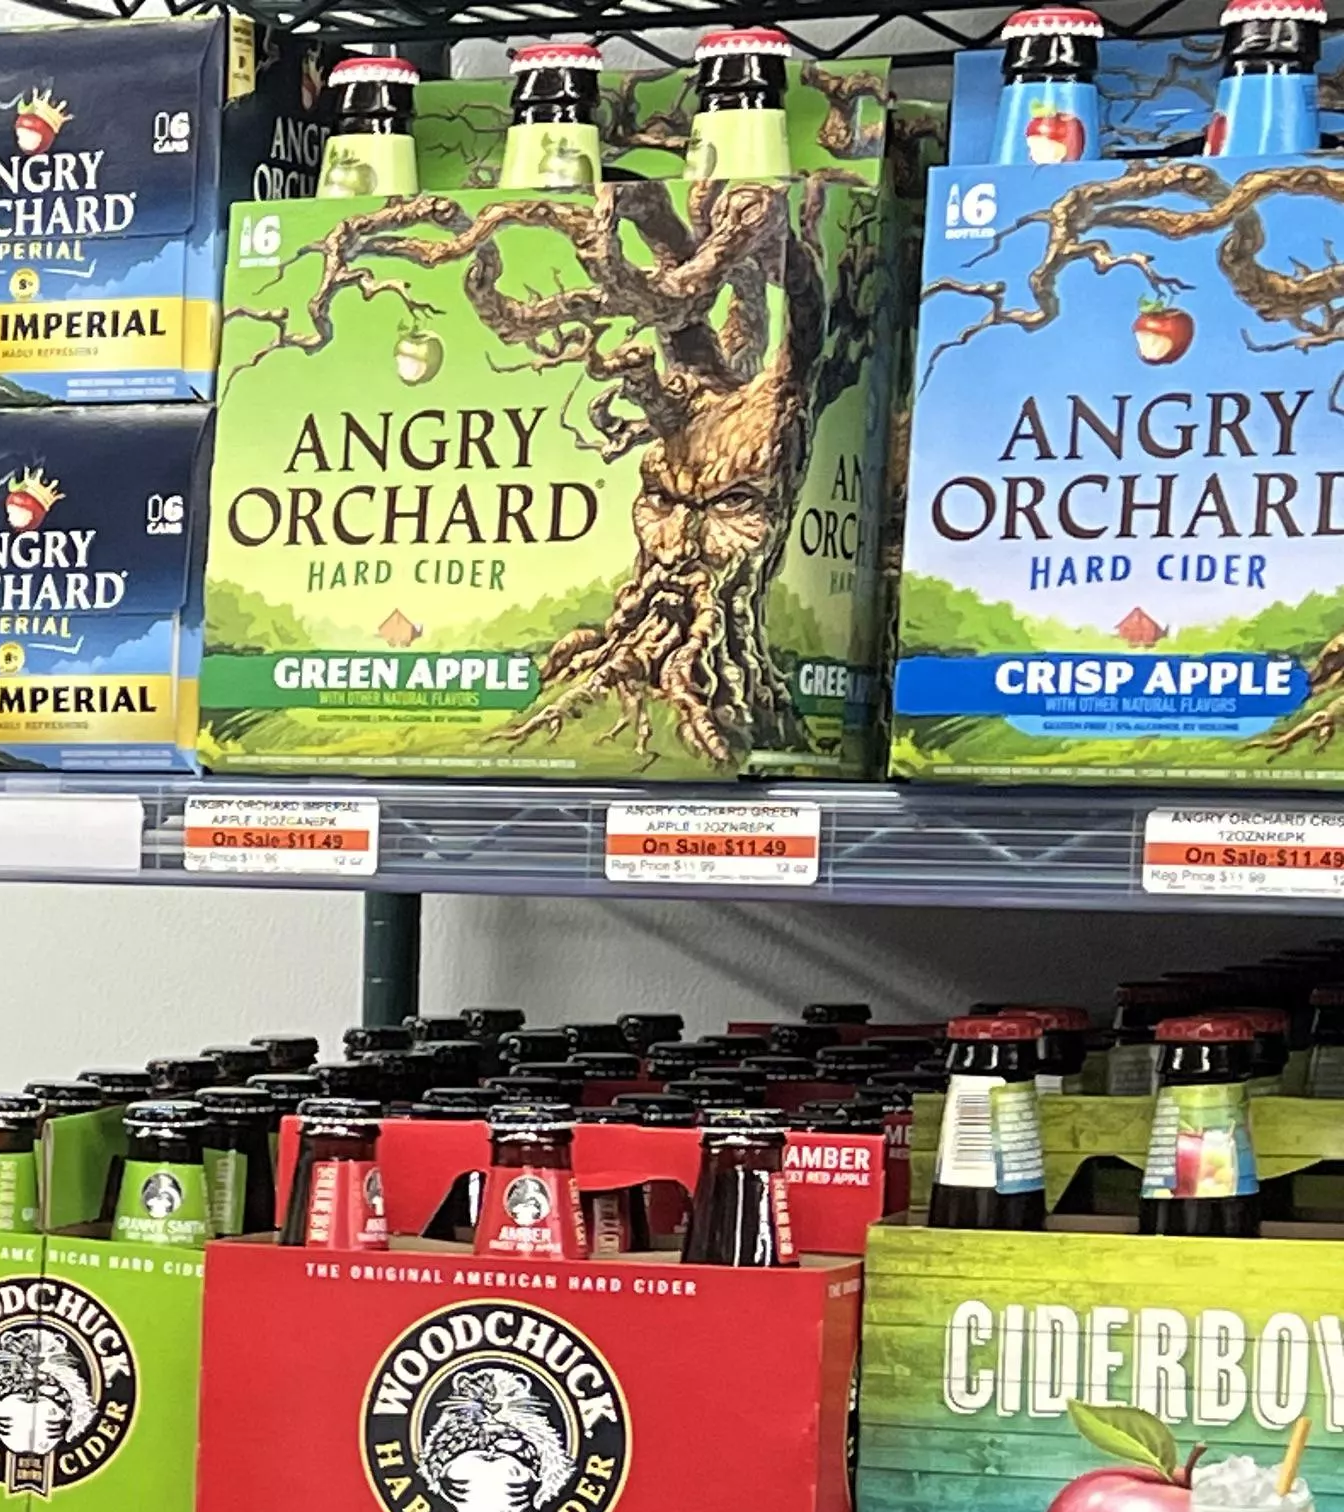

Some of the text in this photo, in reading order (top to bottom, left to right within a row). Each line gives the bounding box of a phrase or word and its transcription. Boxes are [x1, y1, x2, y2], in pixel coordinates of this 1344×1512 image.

[170, 111, 189, 140] 6
[152, 140, 189, 154] CANS
[963, 183, 998, 226] 6
[253, 214, 282, 257] 6
[0, 309, 167, 342] IMPERIAL
[284, 407, 548, 473] ANGRY
[998, 390, 1312, 462] ANGRY
[162, 495, 184, 521] 6
[227, 481, 599, 547] ORCHARD
[306, 558, 506, 593] HARD CIDER
[1029, 554, 1268, 590] HARD CIDER
[274, 655, 530, 691] GREEN APPLE
[994, 660, 1293, 697] CRISP APPLE
[1044, 697, 1075, 713] WITH
[1180, 698, 1237, 714] FLAVORS
[625, 805, 800, 818] ANGRY ORCHARD GREEN
[645, 821, 690, 832] APPLE
[1170, 811, 1307, 827] ANGRY ORCHARD
[211, 832, 238, 848] On
[642, 838, 670, 855] On
[1185, 847, 1216, 865] On
[784, 1145, 872, 1172] AMBER
[108, 1255, 154, 1273] HARD
[163, 1260, 205, 1278] CIDE
[305, 1262, 698, 1298] THE ORIGINAL AMERICAN HARD CIDER
[372, 1309, 619, 1440] WOODCHUCK
[59, 1400, 129, 1476] CIDER
